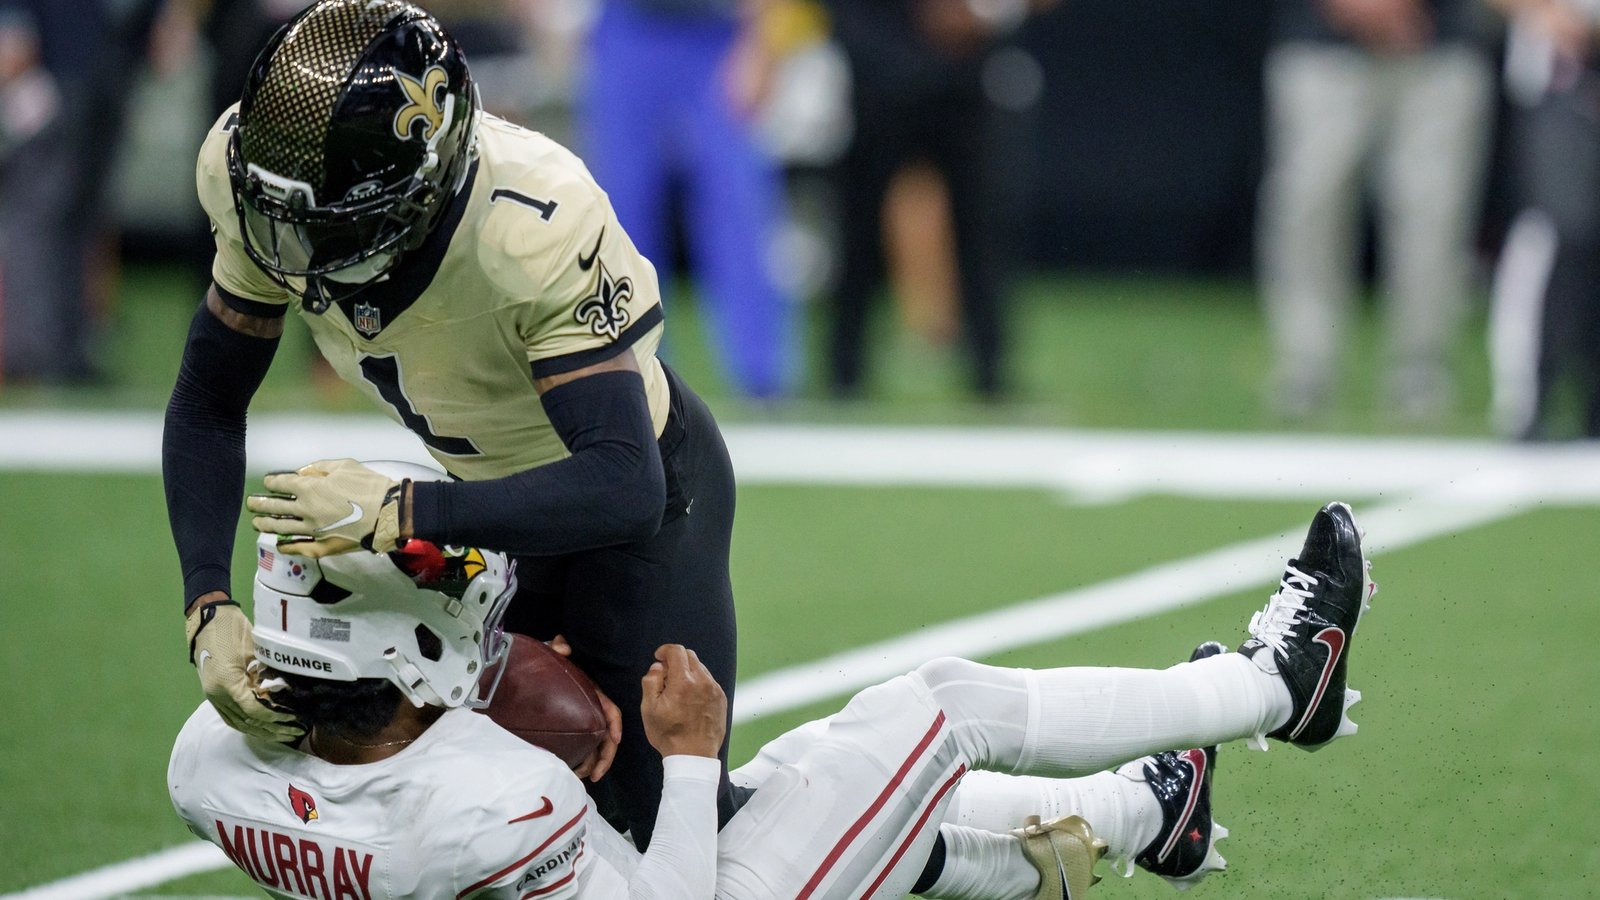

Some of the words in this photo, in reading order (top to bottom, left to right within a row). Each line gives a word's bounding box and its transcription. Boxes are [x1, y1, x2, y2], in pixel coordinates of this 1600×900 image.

[490, 188, 559, 222] 1
[360, 317, 377, 330] NFL
[358, 354, 484, 457] 1
[281, 599, 288, 631] 1
[274, 652, 333, 672] CHANGE
[215, 819, 374, 900] MURRAY
